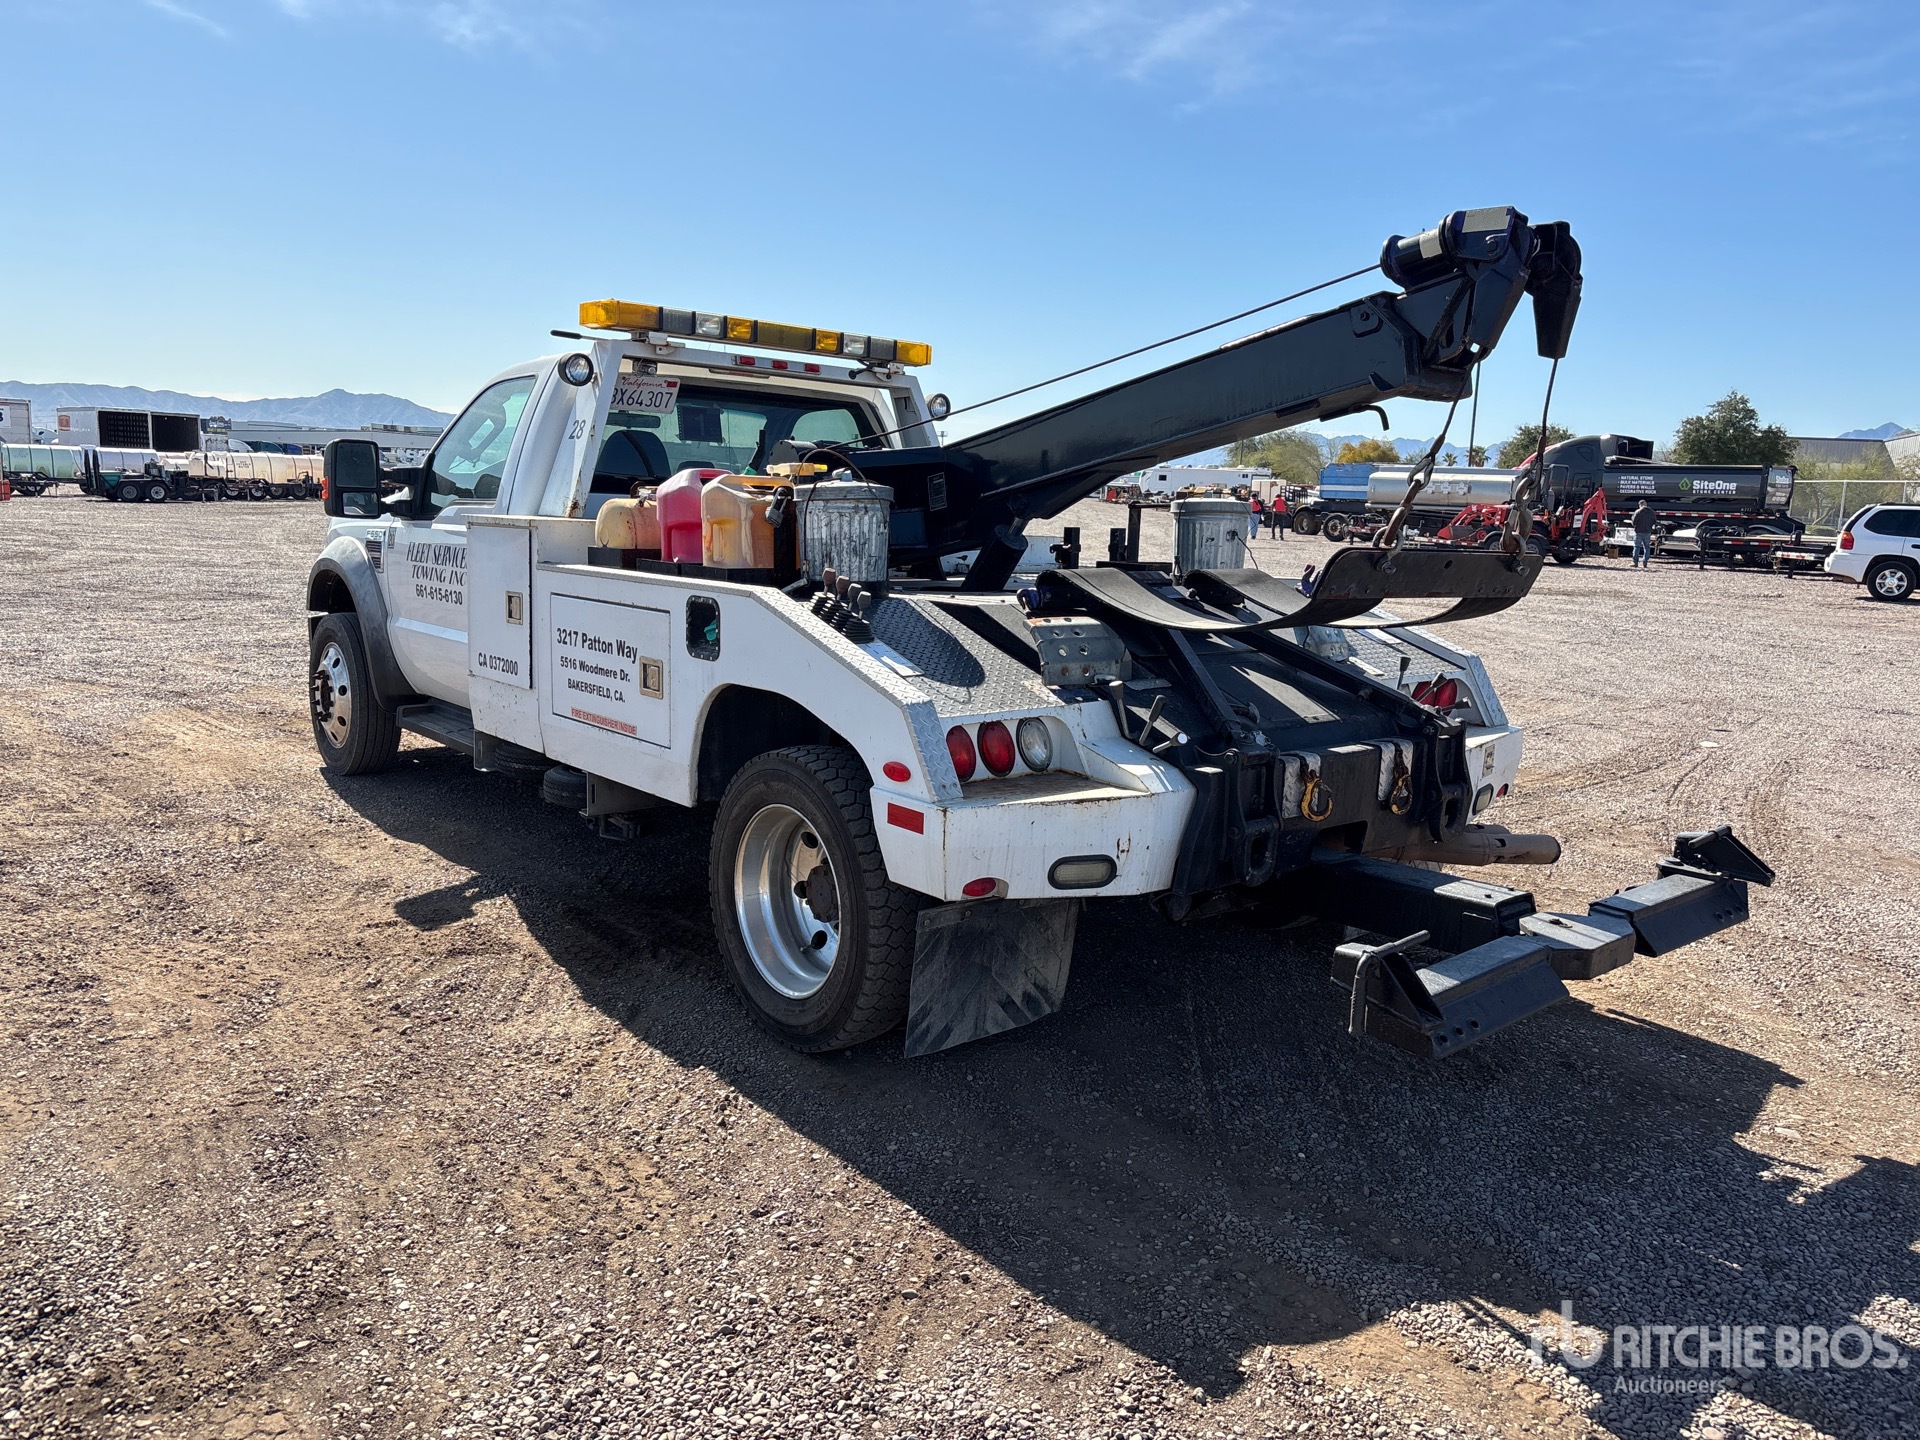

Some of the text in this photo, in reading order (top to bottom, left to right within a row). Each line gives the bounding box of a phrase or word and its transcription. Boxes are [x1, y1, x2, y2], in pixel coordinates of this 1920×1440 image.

[622, 377, 664, 389] California
[568, 419, 586, 440] 28
[1692, 480, 1737, 490] SiteOne
[406, 541, 468, 569] FLEET SERVICE
[412, 564, 447, 583] TOWING
[415, 583, 463, 606] 661-615-6130
[556, 627, 638, 664] 3217 Patton Way
[478, 652, 519, 676] CA 0372000
[560, 655, 631, 683] 5516 Woodmere Dr.
[567, 678, 626, 703] BAKERSFIELD, CA.
[571, 707, 636, 734] FIRE EXTINGUISHER INSIDE
